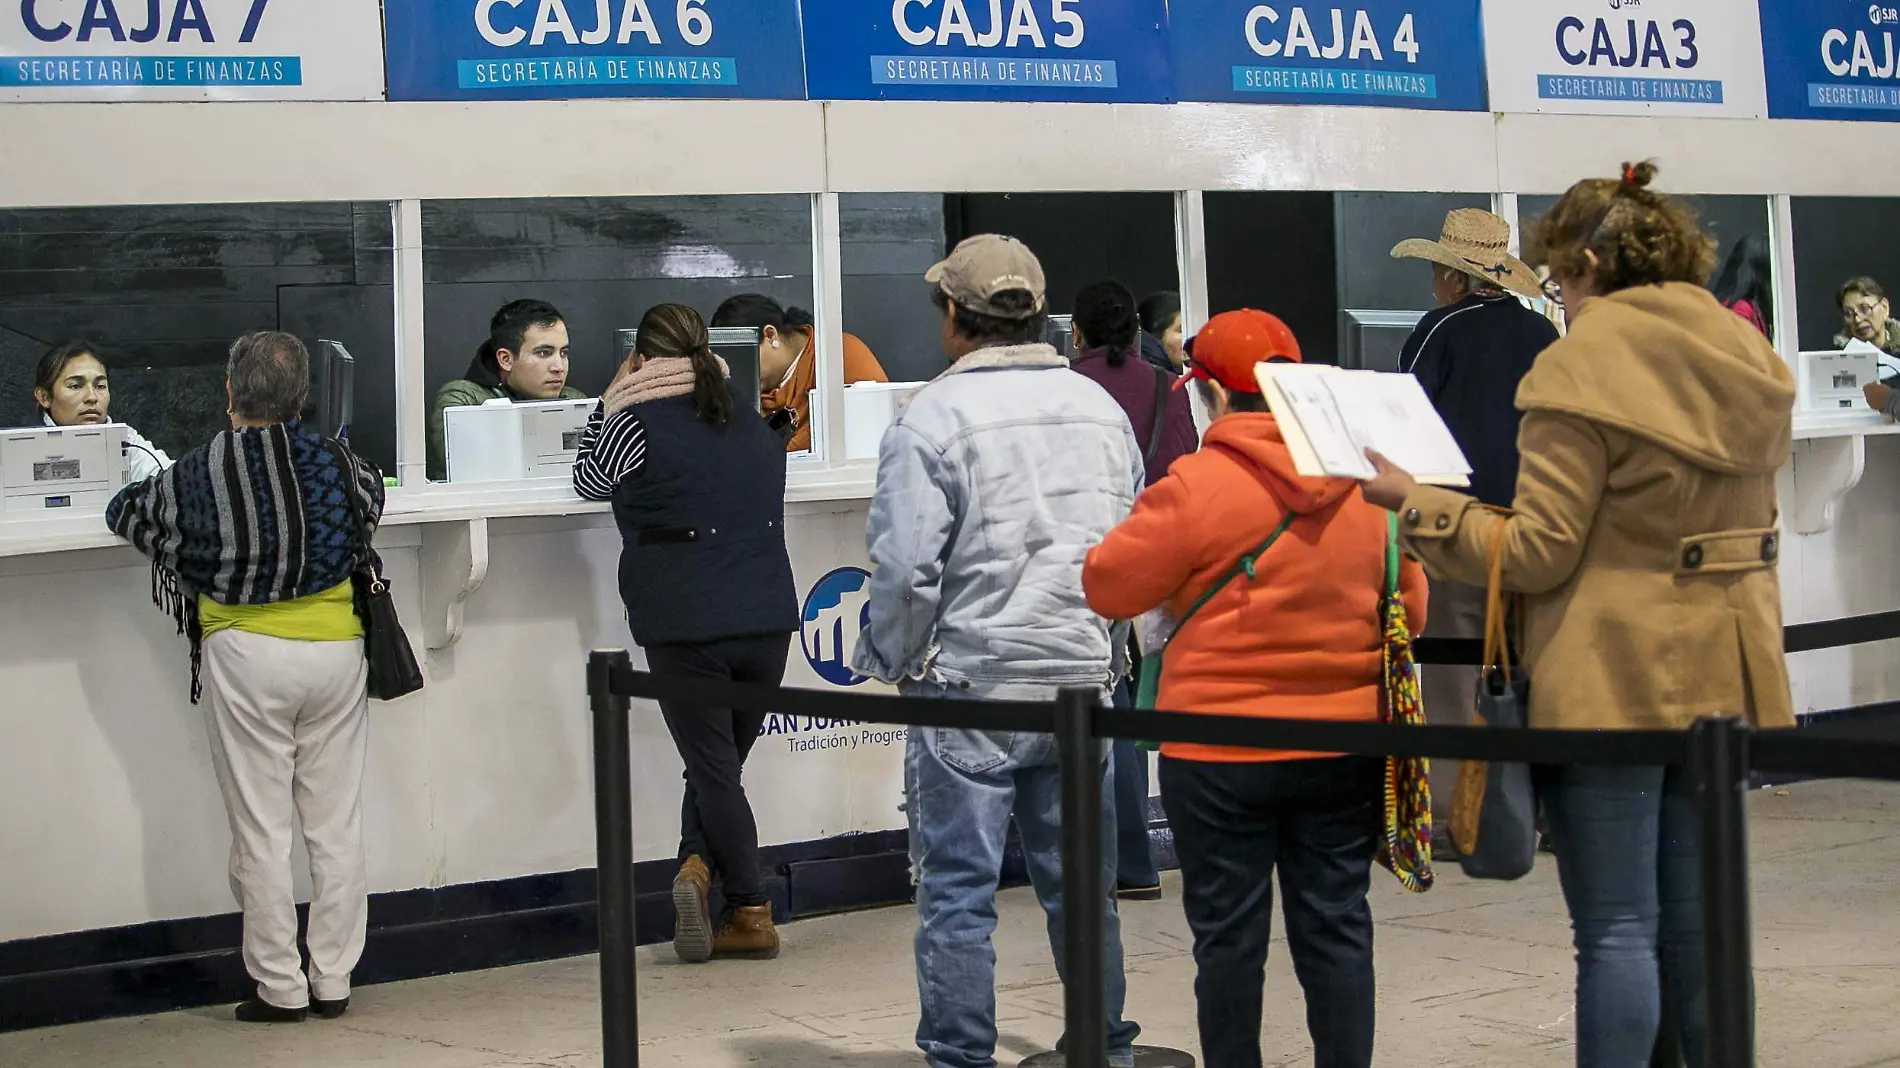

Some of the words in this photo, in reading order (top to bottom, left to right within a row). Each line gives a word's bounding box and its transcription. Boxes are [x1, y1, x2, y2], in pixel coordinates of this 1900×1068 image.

[20, 0, 215, 42] CAJA
[474, 0, 662, 47] CAJA
[676, 0, 713, 46] 6
[891, 0, 1046, 48] CAJA
[1052, 0, 1085, 49] 5
[1882, 7, 1898, 21] SJR
[1244, 5, 1384, 61] CAJA
[1393, 13, 1420, 63] 4
[1555, 16, 1671, 68] CAJA
[1672, 18, 1699, 69] 3
[18, 57, 144, 82] SECRETARÍA
[154, 60, 176, 81] DE
[187, 60, 284, 81] FINANZAS
[476, 58, 598, 83] SECRETARÍA
[608, 60, 629, 80] DE
[638, 60, 722, 80] FINANZAS
[887, 59, 990, 81] SECRETARÍA
[998, 62, 1017, 81] DE
[1025, 62, 1103, 83] FINANZAS
[1245, 69, 1335, 89] SECRETARÍA
[1341, 72, 1358, 90] DE
[1364, 73, 1426, 93] FINANZAS
[1549, 77, 1627, 97] SECRETARÍA
[1632, 82, 1647, 98] DE
[1653, 82, 1713, 100] FINANZAS
[787, 733, 848, 752] Tradición
[850, 735, 859, 750] y
[861, 729, 908, 747] Progres
